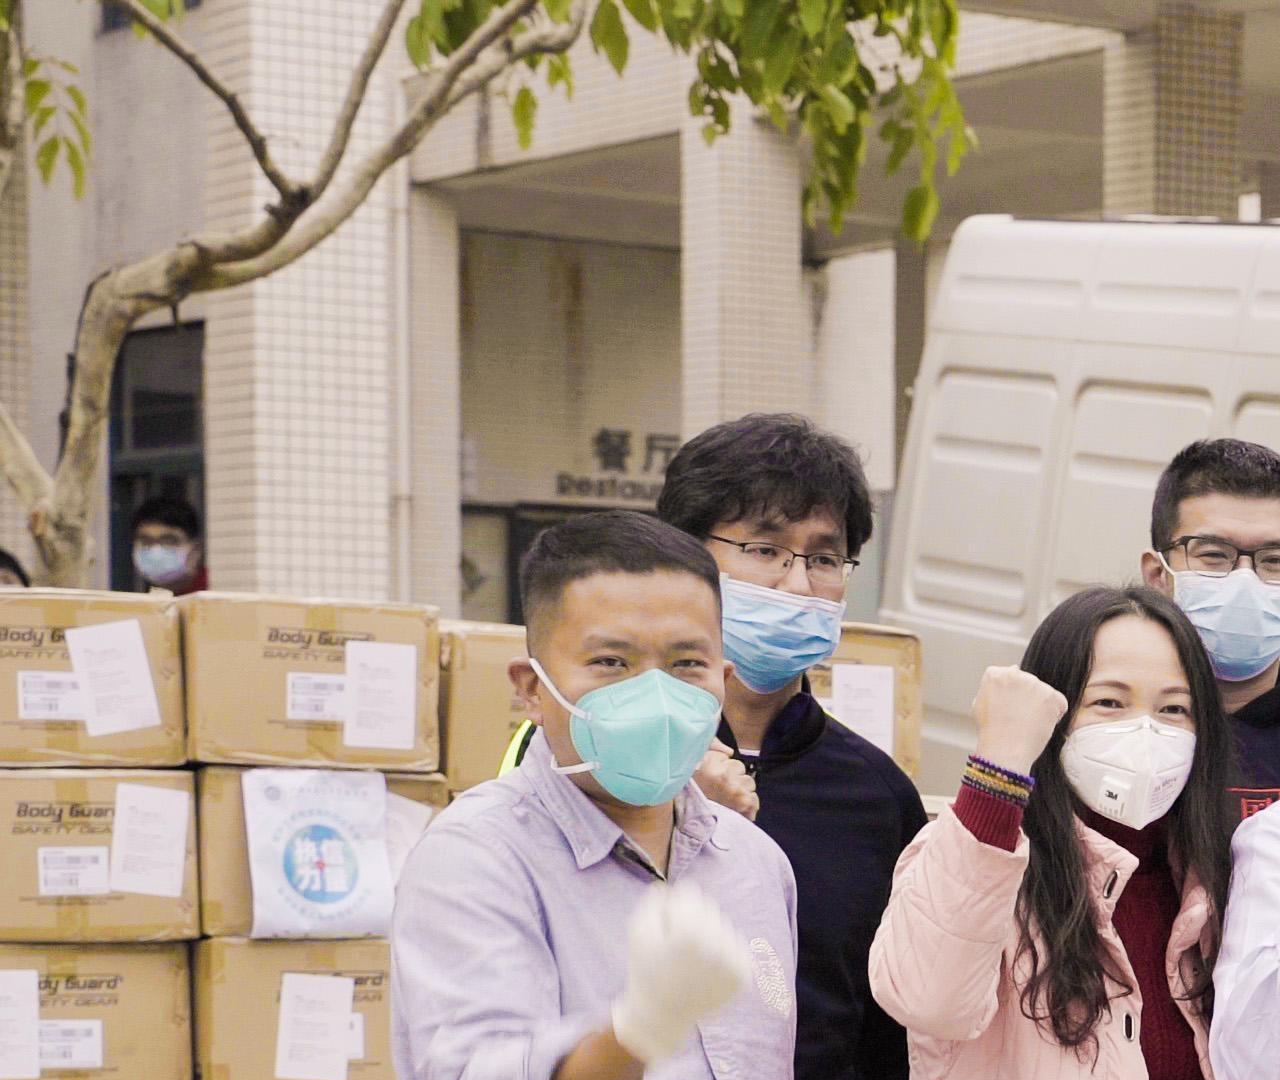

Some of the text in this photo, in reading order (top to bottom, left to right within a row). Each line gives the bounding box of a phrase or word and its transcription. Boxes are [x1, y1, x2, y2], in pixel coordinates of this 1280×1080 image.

[593, 426, 682, 472] 餐厅
[557, 472, 665, 498] Restau
[268, 627, 312, 648] Body
[16, 802, 114, 821] Body Guar
[11, 825, 112, 835] SAFETY GEA
[64, 975, 119, 991] Guard
